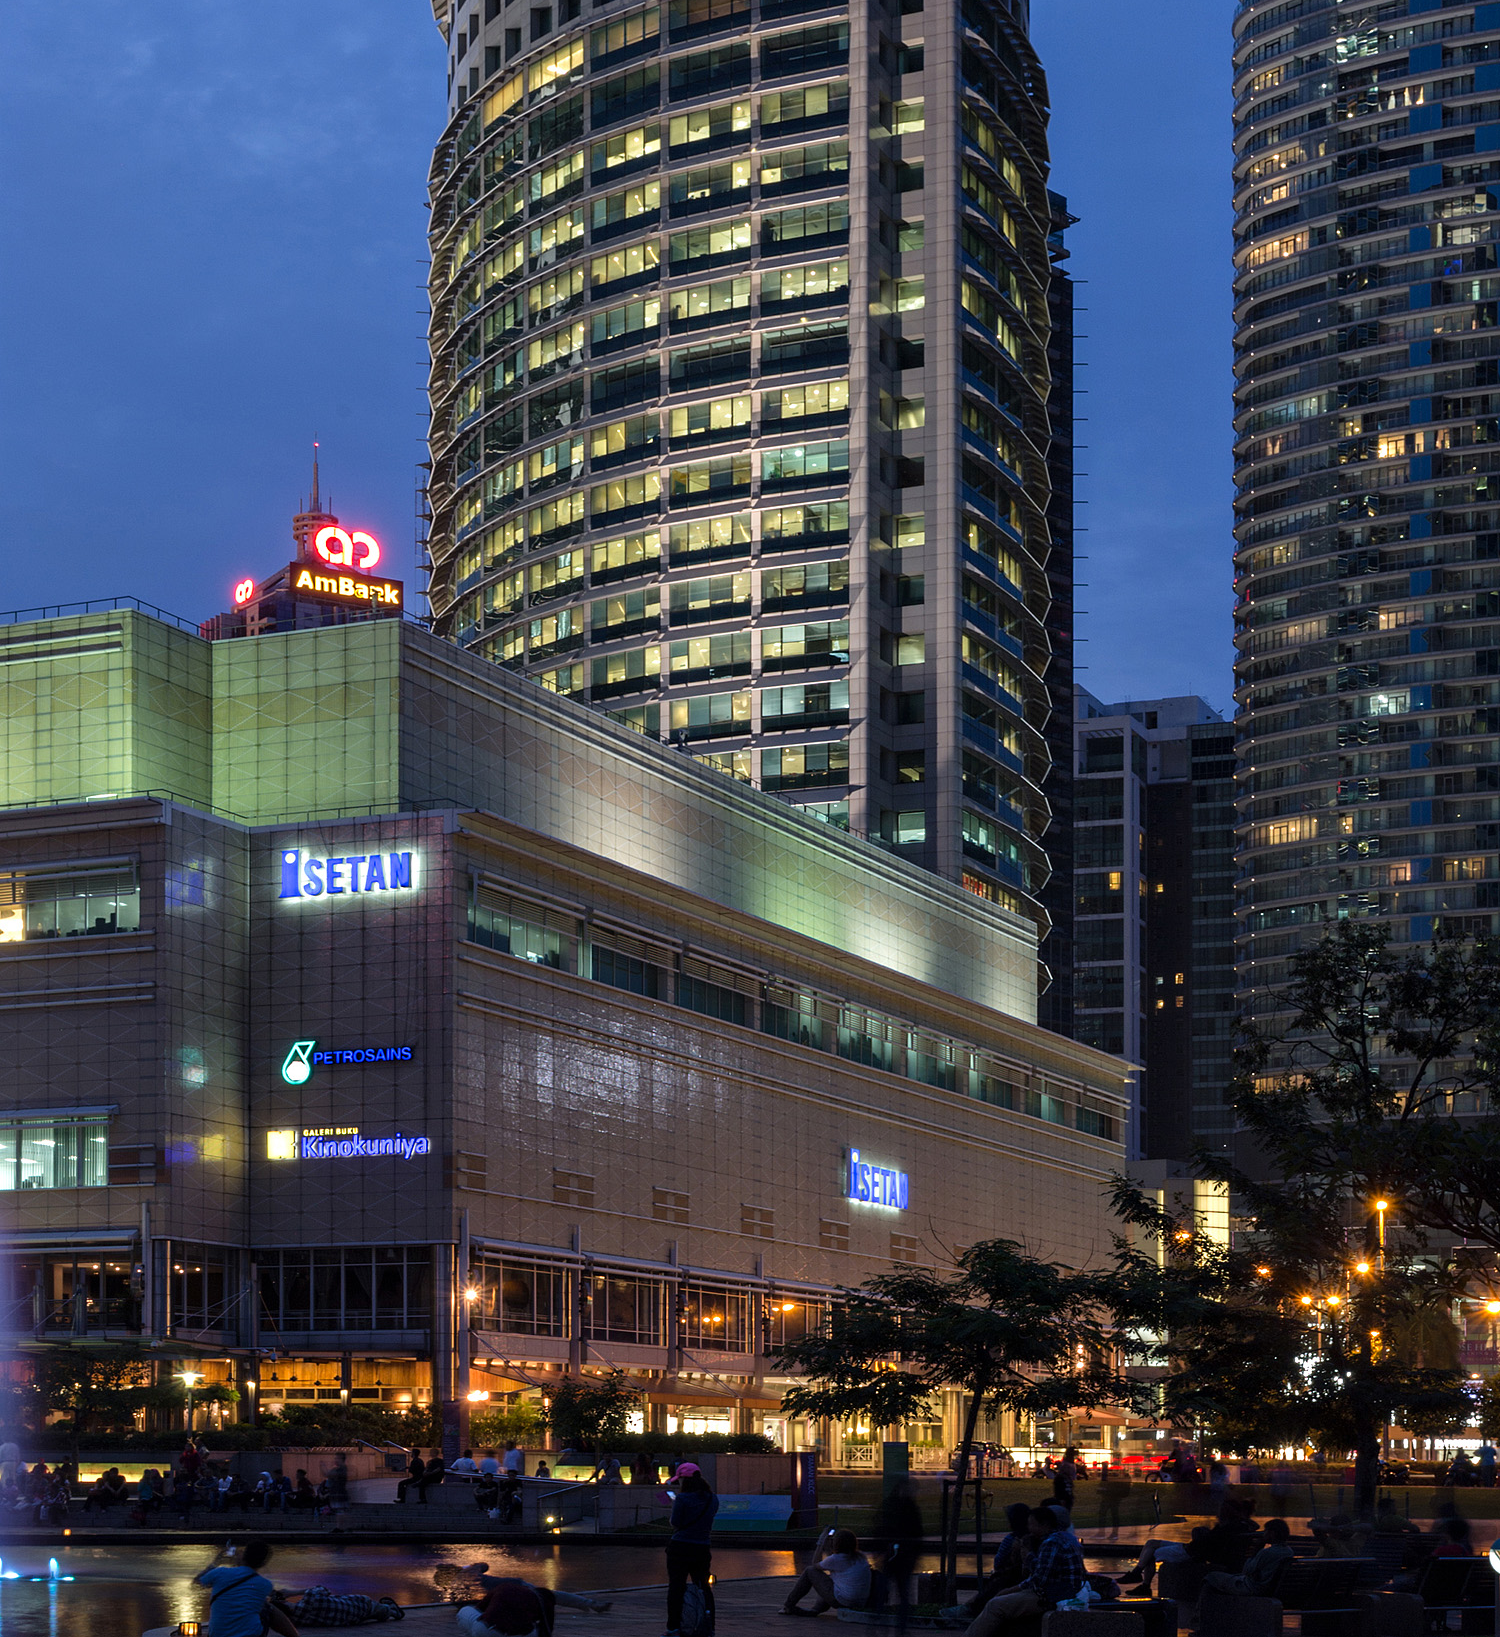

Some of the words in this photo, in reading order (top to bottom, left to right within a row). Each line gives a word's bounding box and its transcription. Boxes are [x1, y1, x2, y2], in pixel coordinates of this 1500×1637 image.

[296, 570, 399, 604] AmBank
[313, 1047, 412, 1065] PETROSAINS
[303, 1128, 334, 1137] GALERI
[336, 1127, 359, 1135] BUKU
[301, 1133, 430, 1159] Kinokuniya
